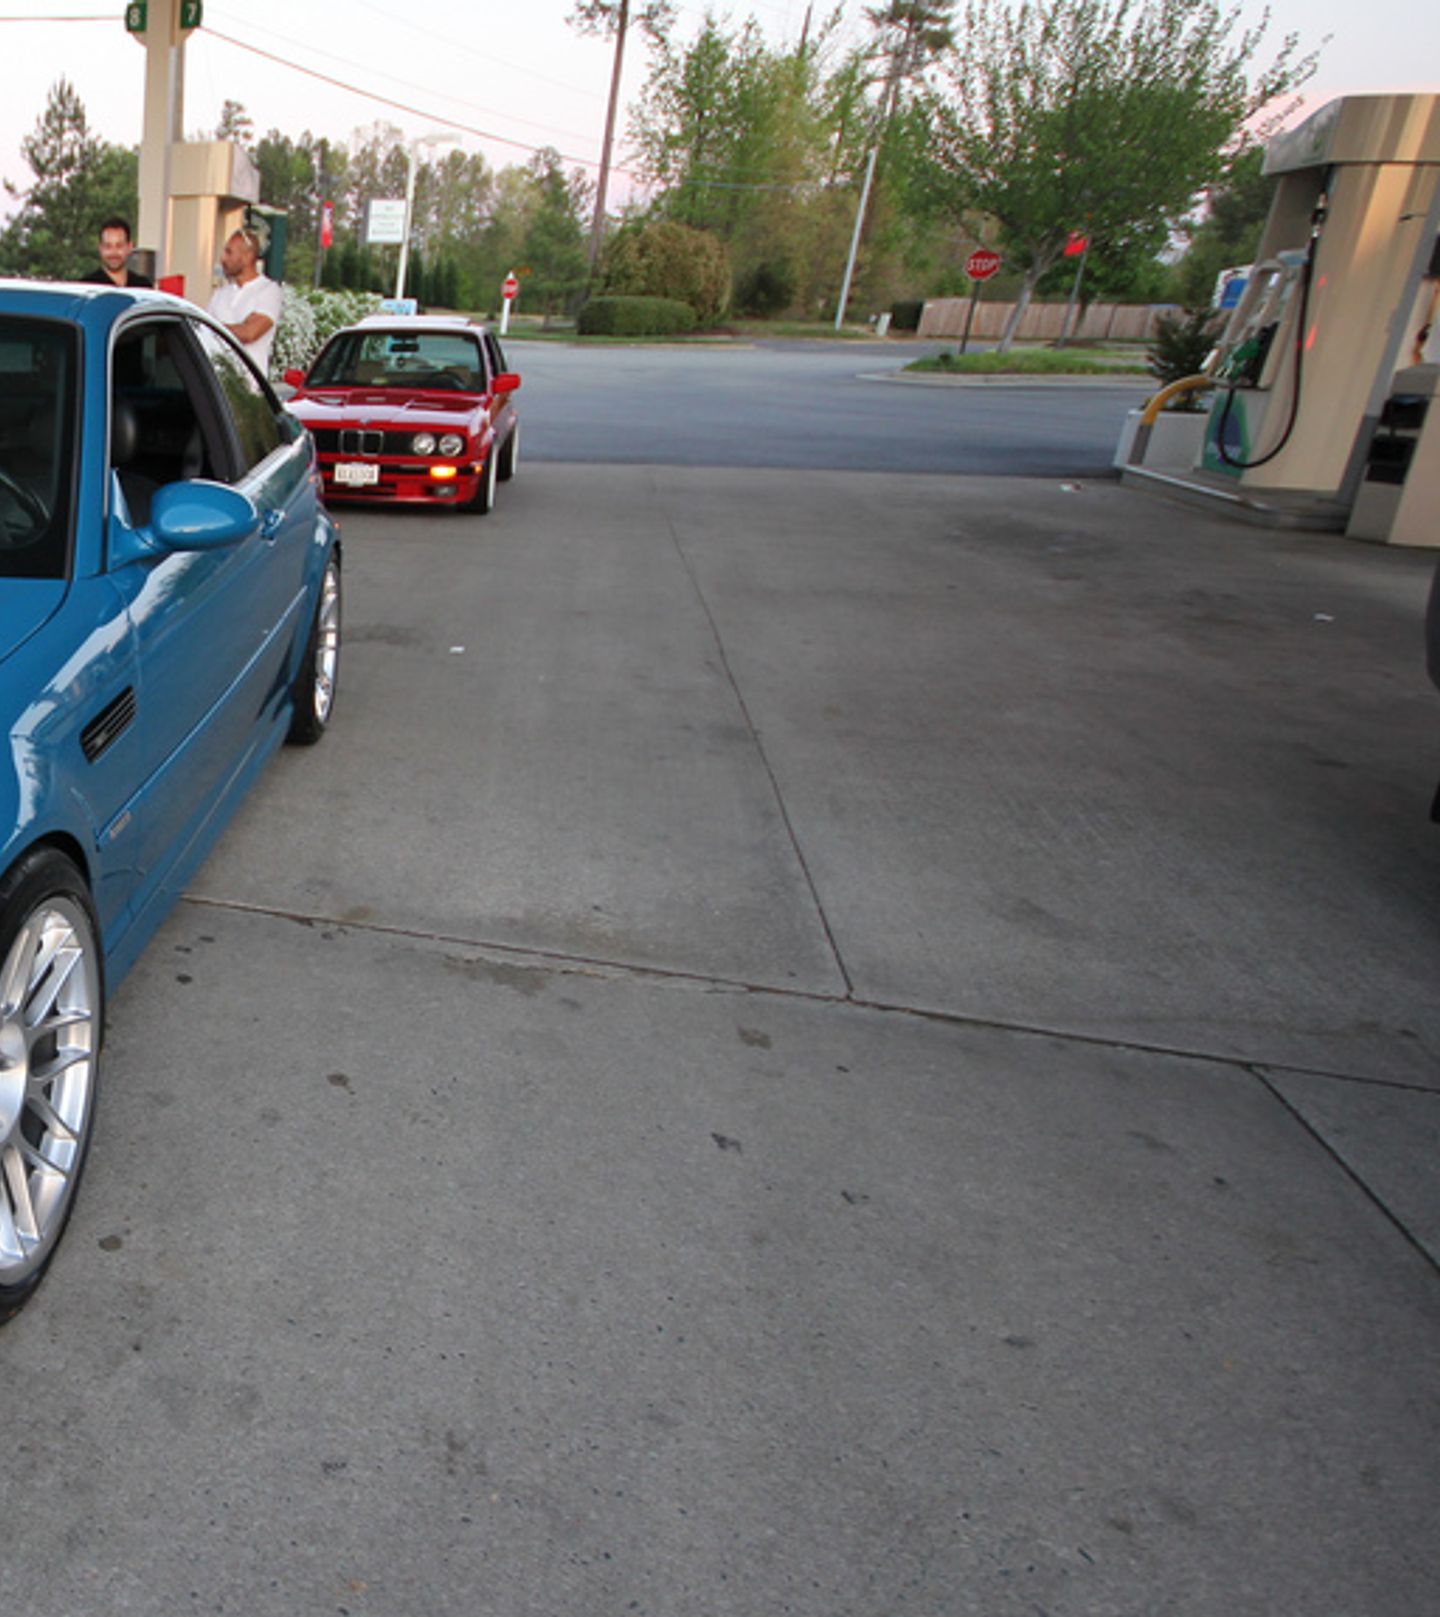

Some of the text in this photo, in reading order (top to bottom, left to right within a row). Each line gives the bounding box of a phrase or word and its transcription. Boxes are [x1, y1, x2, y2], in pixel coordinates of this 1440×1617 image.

[129, 6, 141, 27] 8
[187, 2, 198, 23] 7
[967, 257, 998, 271] STOP
